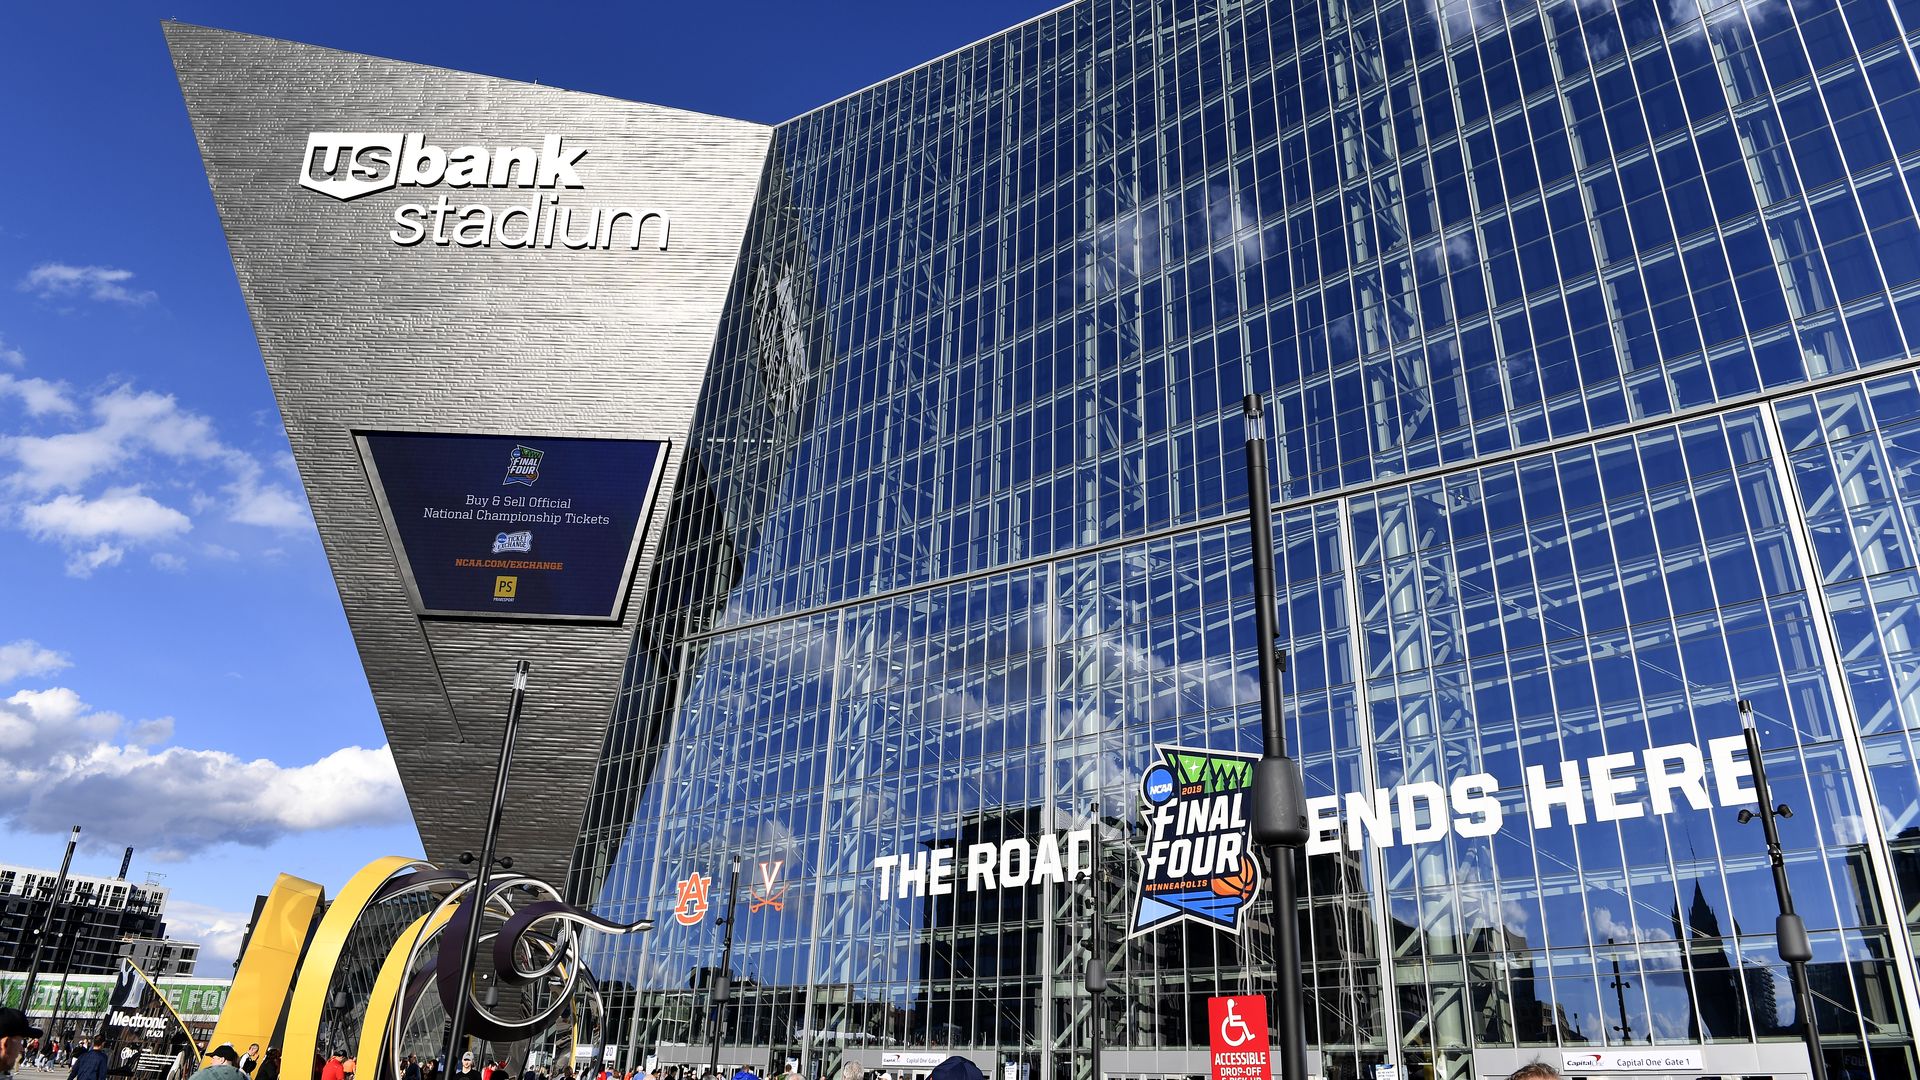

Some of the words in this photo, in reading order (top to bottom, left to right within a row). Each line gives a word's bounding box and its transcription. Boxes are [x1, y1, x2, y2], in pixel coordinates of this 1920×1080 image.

[390, 194, 671, 250] stadium
[513, 457, 538, 466] FINAL
[510, 465, 536, 475] FOUR
[465, 494, 489, 508] Buy
[492, 495, 501, 507] &
[503, 496, 525, 507] Sell
[529, 497, 572, 509] Official
[423, 507, 473, 520] National
[476, 509, 562, 525] Championship
[565, 512, 610, 525] Tickets
[508, 534, 528, 542] TICKET
[455, 558, 564, 570] NCAA.COM/EXCHANGE
[499, 580, 513, 592] PS
[1150, 782, 1173, 795] NCAA
[1181, 785, 1202, 796] 2019
[1306, 772, 1504, 856] ENDS
[1525, 735, 1773, 830] HERE
[1152, 792, 1246, 841] FINAL
[1147, 833, 1243, 881] FOUR
[874, 847, 954, 901] THE
[966, 829, 1092, 892] ROAD
[1145, 879, 1208, 892] MINNEAPOLIS
[109, 1010, 168, 1030] Medtronic
[146, 1029, 163, 1038] PLAZA
[605, 1046, 613, 1057] 20
[1215, 1052, 1266, 1065] ACCESSIBLE
[1617, 1058, 1644, 1068] Capital
[1665, 1057, 1684, 1066] Gate
[1221, 1067, 1262, 1076] DROP-OFF
